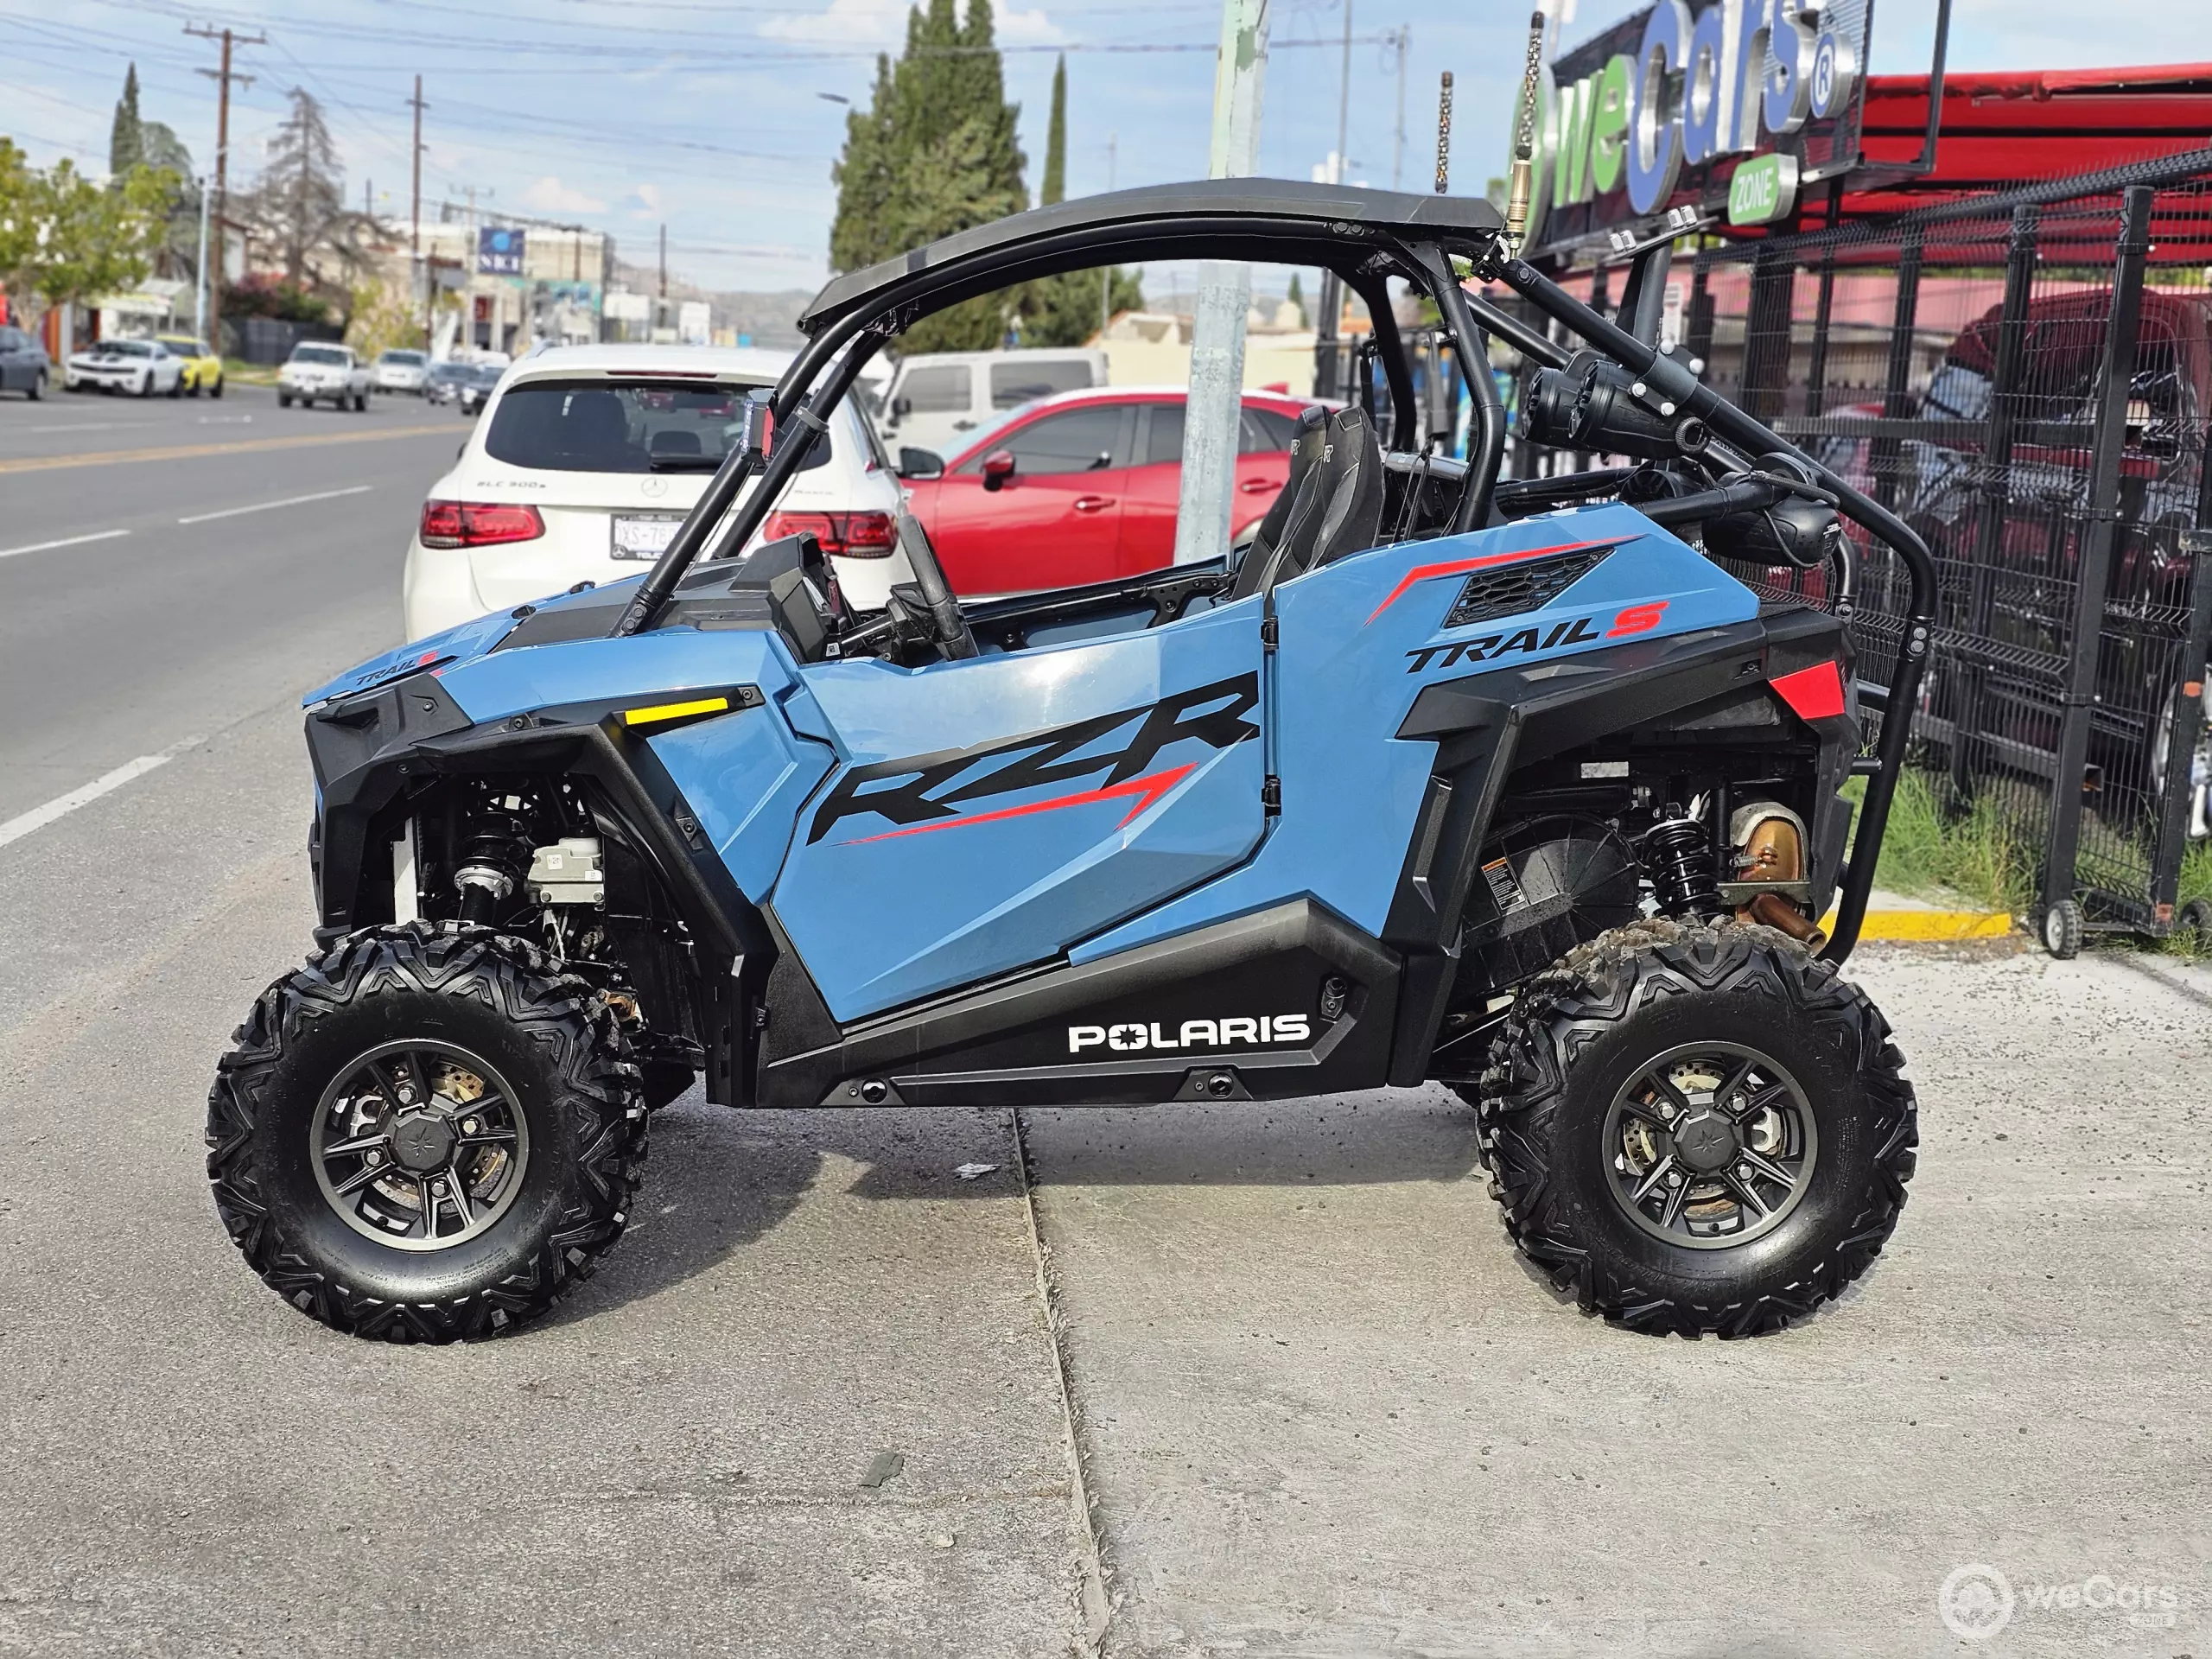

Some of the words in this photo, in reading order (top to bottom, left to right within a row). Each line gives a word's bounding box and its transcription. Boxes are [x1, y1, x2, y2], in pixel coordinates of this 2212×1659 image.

[1735, 168, 1773, 213] ZONE
[1404, 617, 1600, 674] TRAIL
[1605, 601, 1669, 639] S
[356, 660, 416, 685] TRAIL
[417, 651, 439, 666] S
[806, 670, 1260, 846] RZR
[1069, 1014, 1311, 1052] POLARIS
